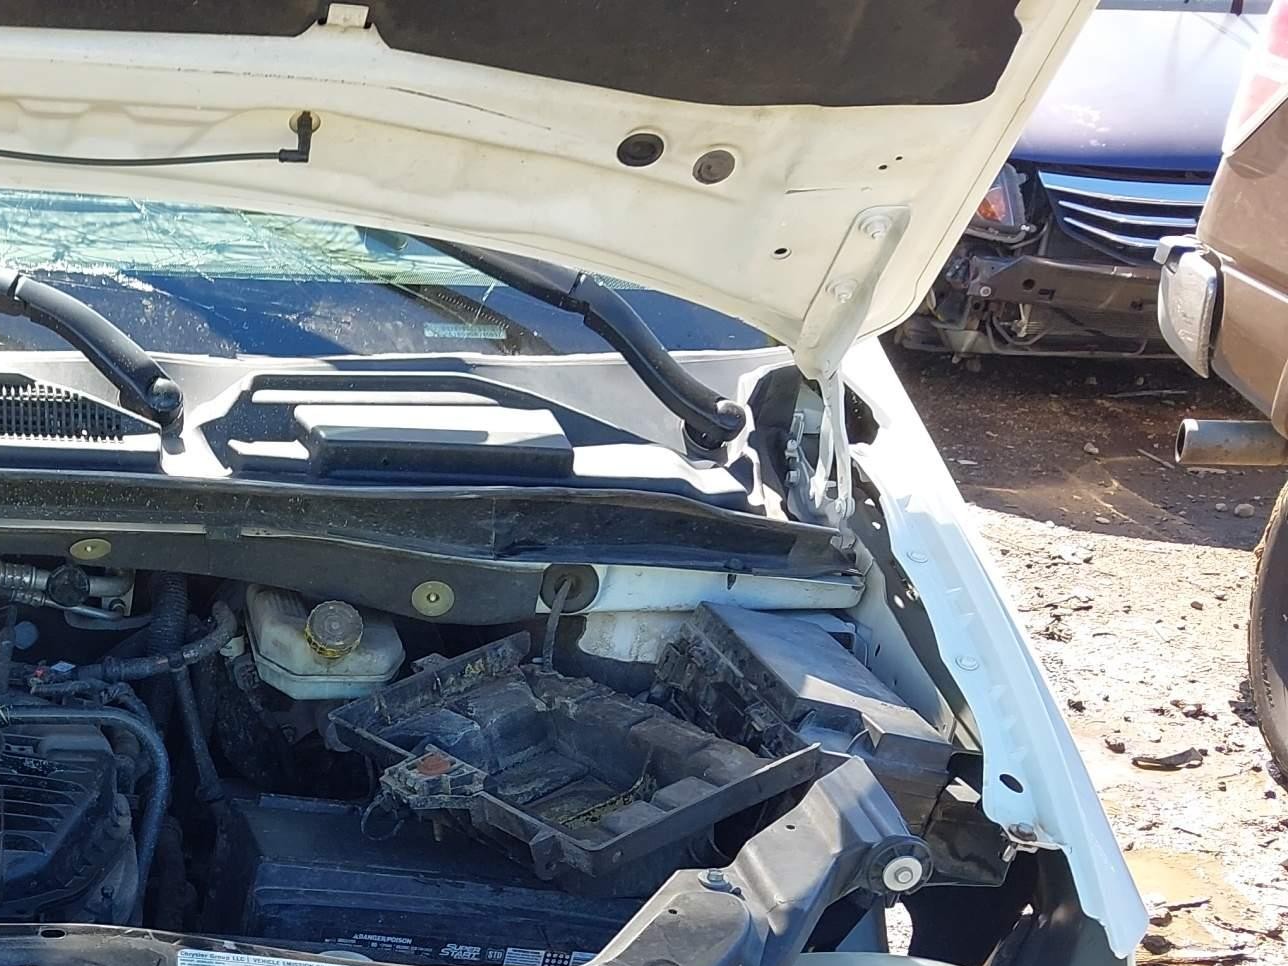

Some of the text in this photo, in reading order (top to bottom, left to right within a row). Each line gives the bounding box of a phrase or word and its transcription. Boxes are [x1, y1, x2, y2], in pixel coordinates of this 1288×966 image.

[438, 948, 480, 958] START
[446, 943, 482, 953] SUPER
[209, 953, 231, 961] Group
[253, 957, 281, 965] VEHICLE
